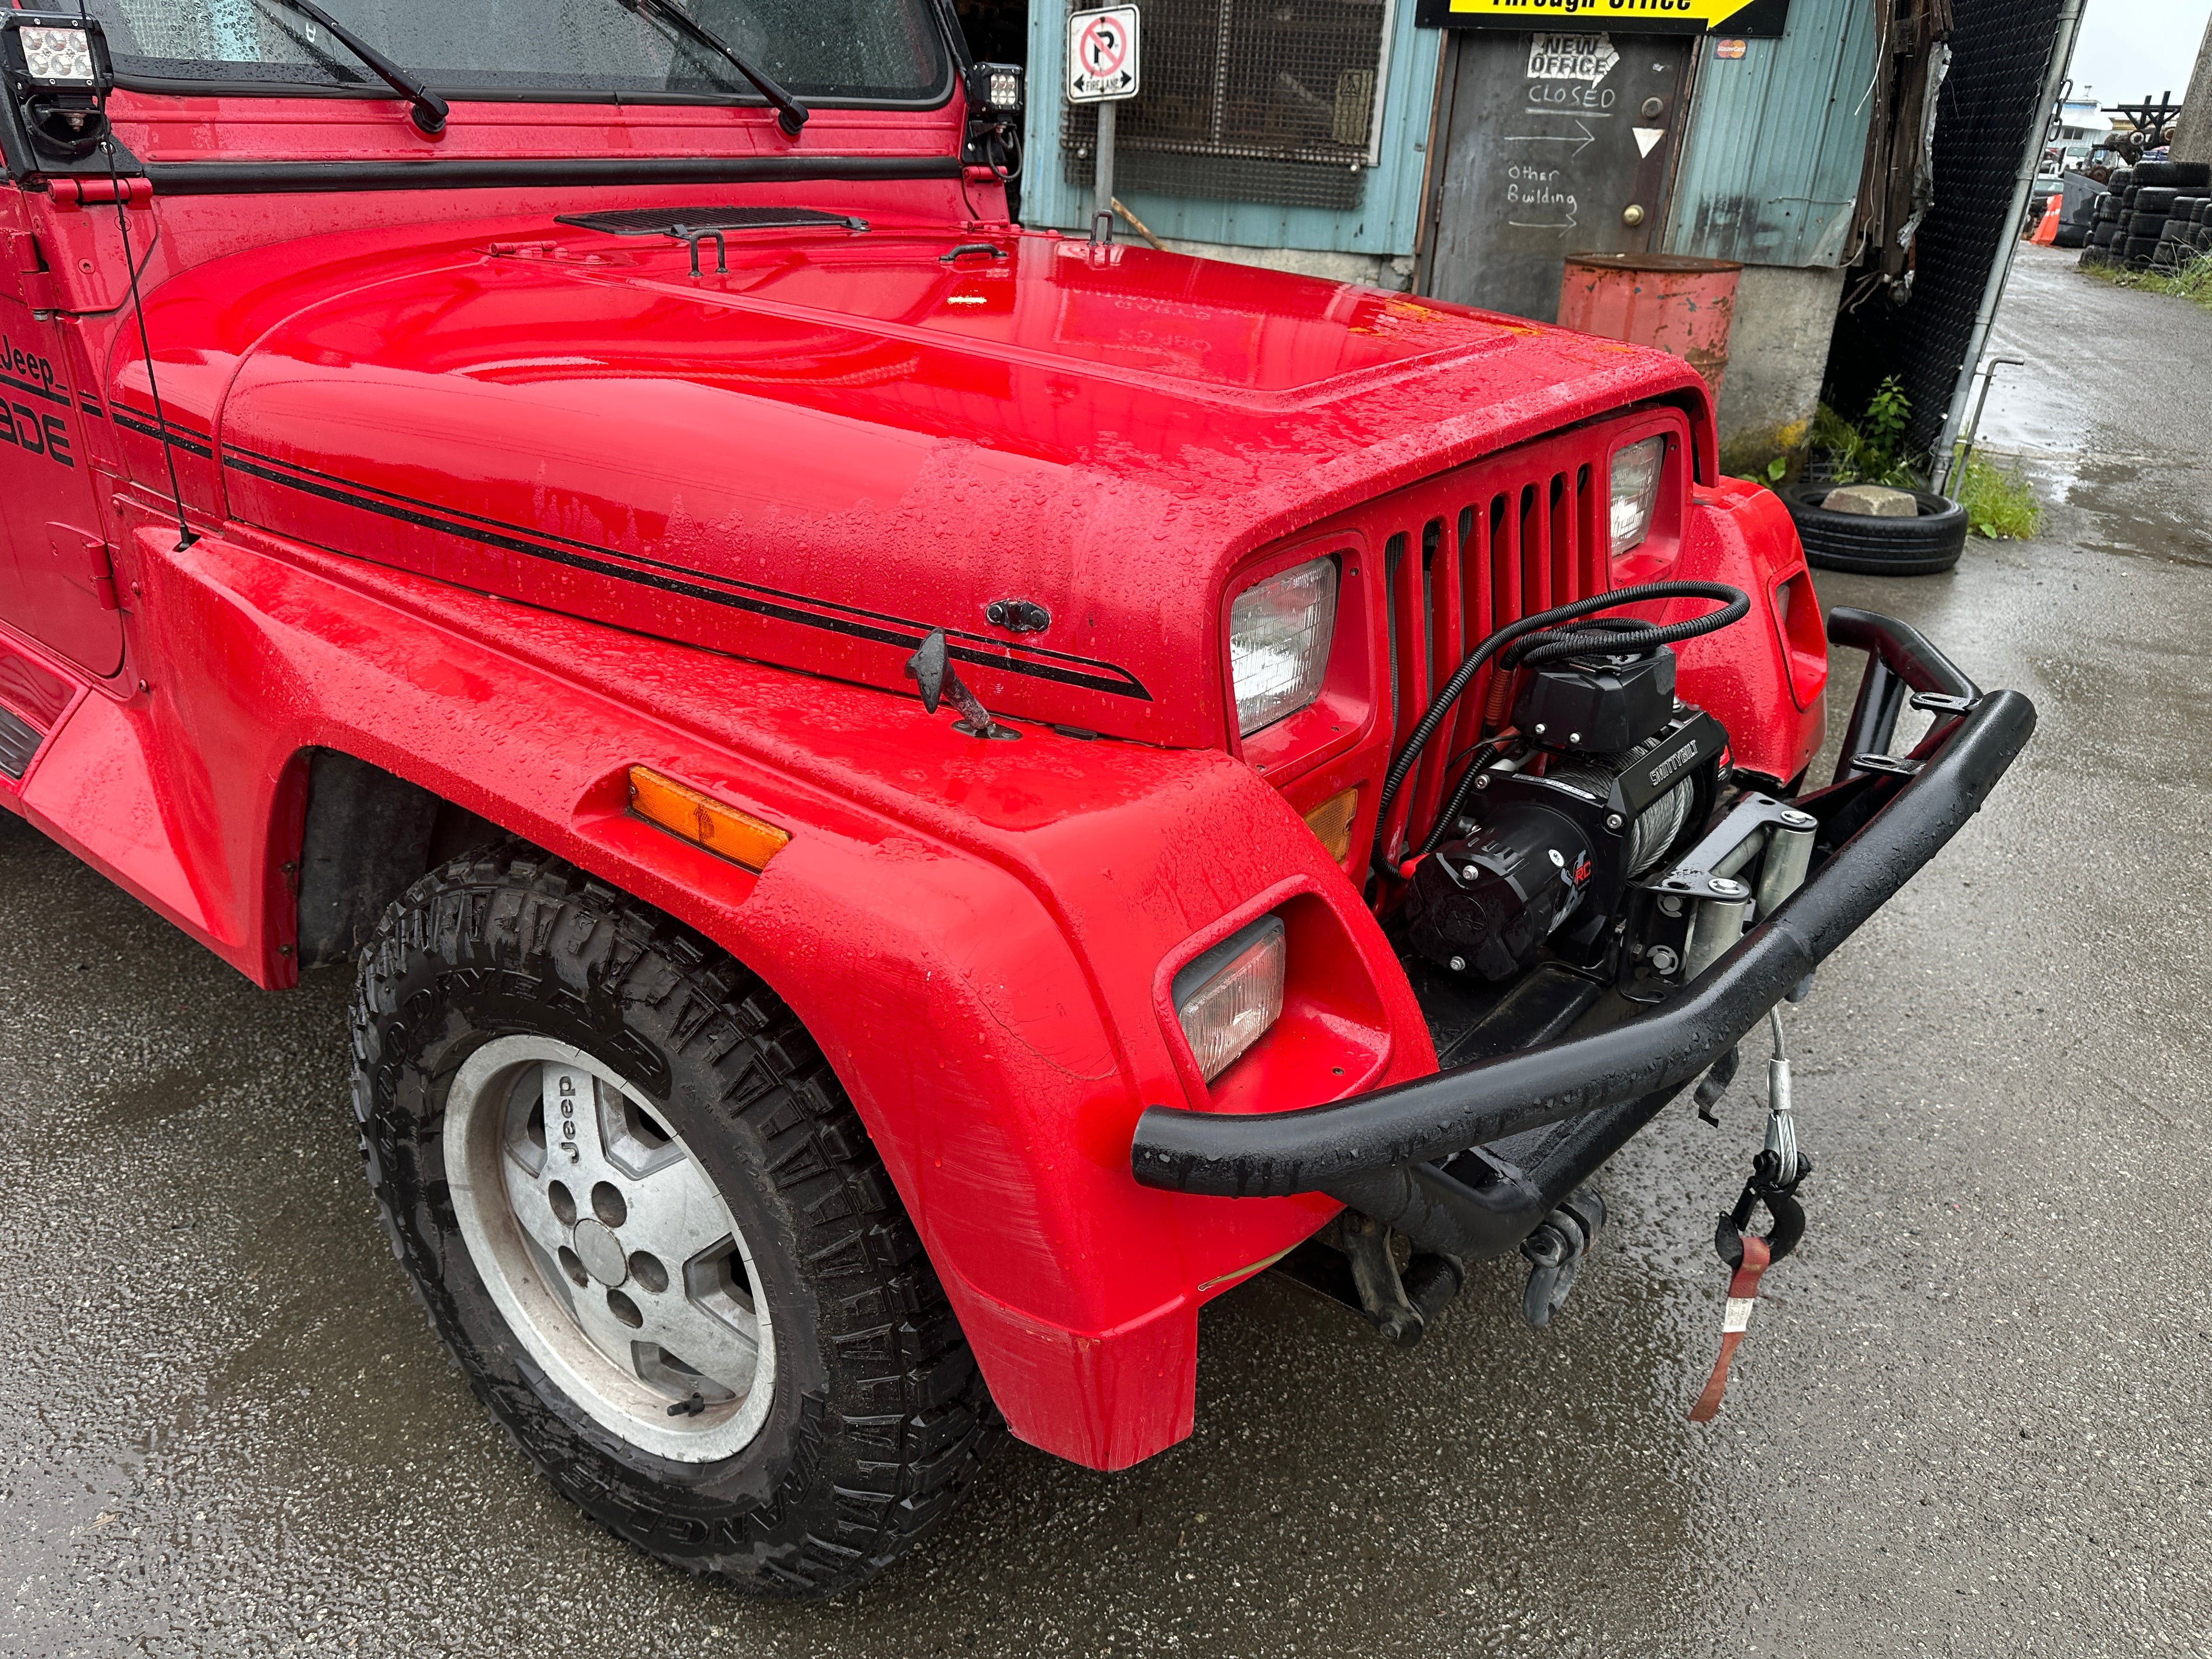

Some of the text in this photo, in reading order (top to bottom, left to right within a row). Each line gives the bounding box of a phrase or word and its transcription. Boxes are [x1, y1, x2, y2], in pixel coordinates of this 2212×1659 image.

[1543, 36, 1597, 55] NEW
[1531, 53, 1607, 74] OFFICE
[1529, 85, 1615, 108] CLOSED
[1508, 165, 1560, 181] Other
[1507, 183, 1578, 216] Building
[1, 334, 54, 392] Jeep
[1649, 739, 1698, 787] SMITTYBILT
[559, 1075, 579, 1164] Jeep
